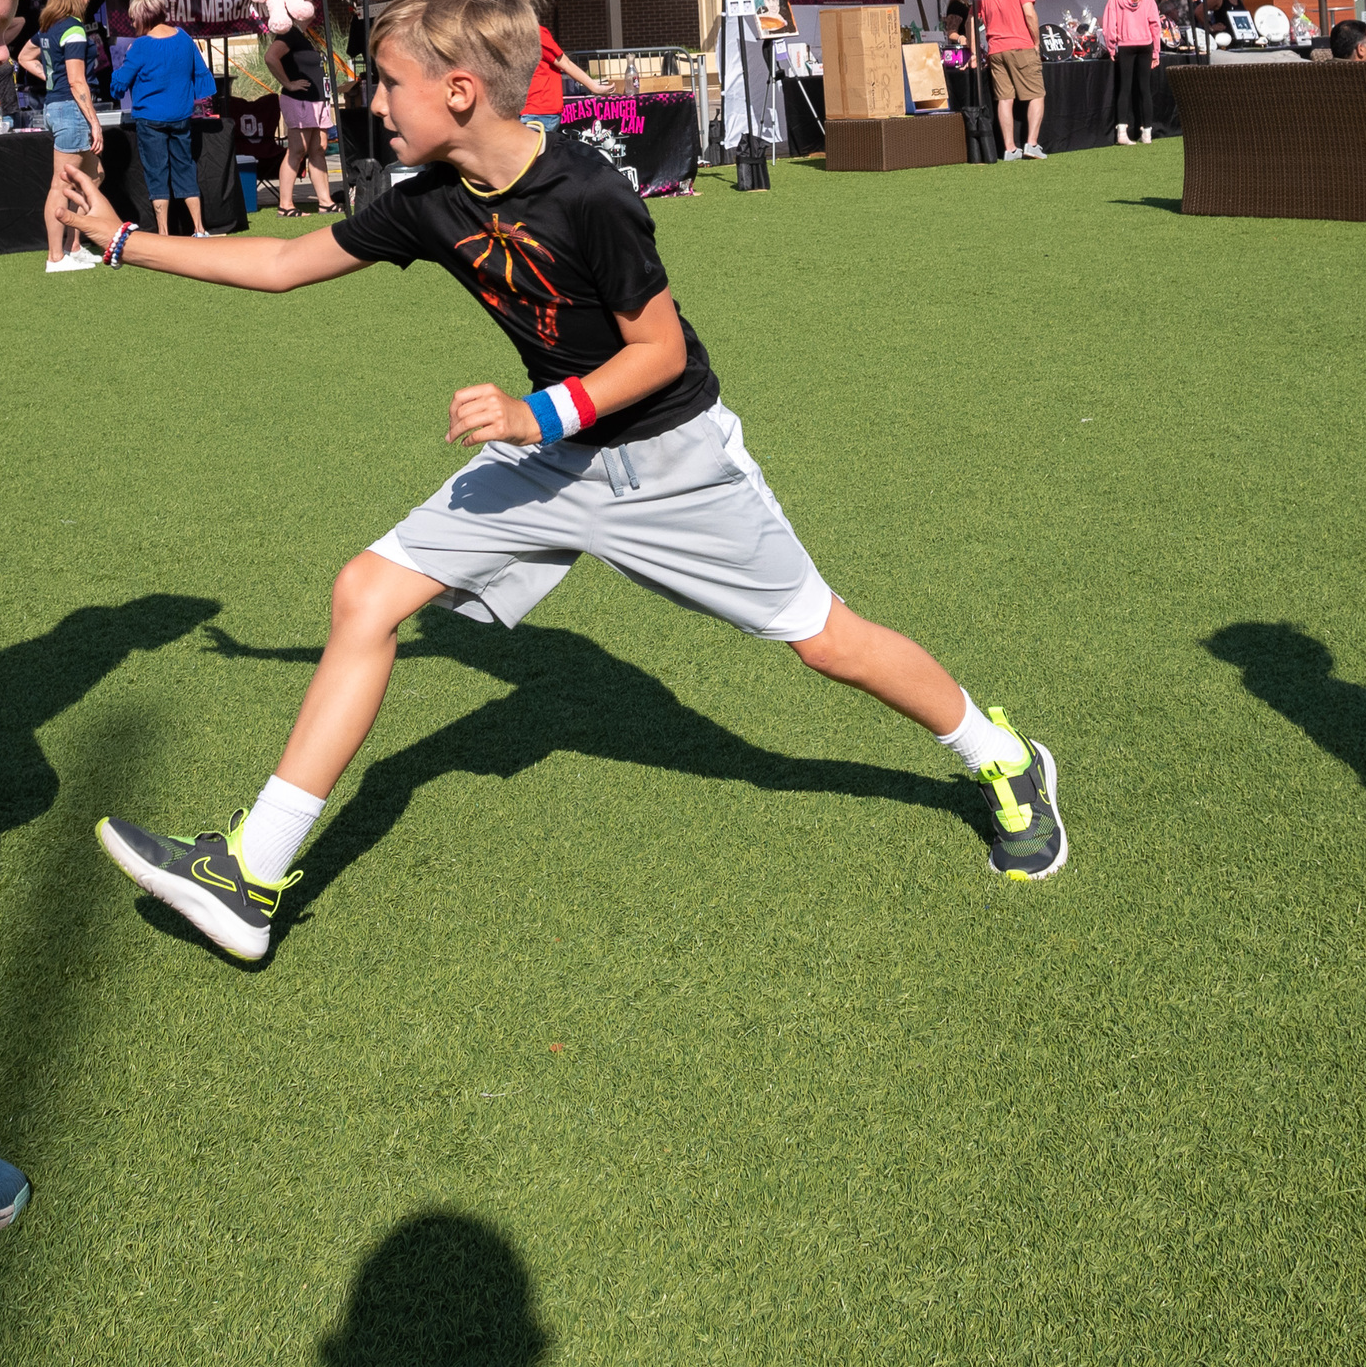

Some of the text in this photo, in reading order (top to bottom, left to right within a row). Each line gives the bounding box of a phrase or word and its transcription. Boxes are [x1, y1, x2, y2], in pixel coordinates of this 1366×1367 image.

[561, 98, 637, 124] BREAST CANCER
[620, 115, 645, 134] CAN
